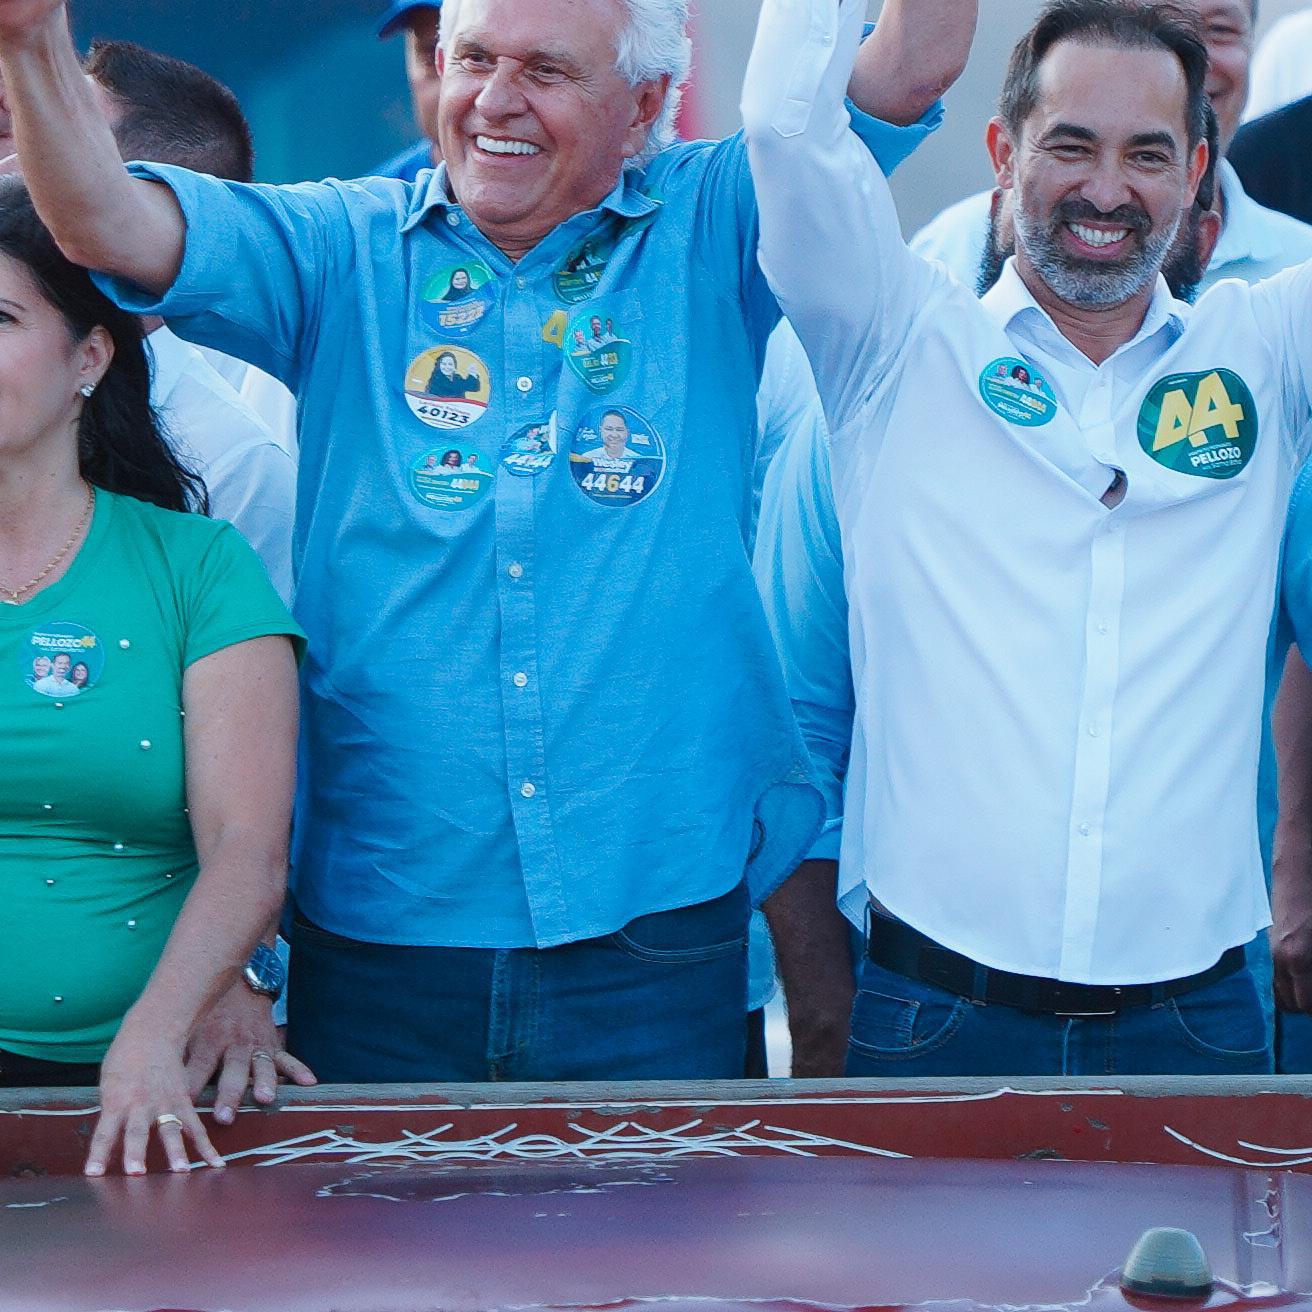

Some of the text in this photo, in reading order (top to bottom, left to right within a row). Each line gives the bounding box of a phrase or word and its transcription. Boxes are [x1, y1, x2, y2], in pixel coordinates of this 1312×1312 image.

[418, 406, 470, 424] 40123
[1153, 371, 1245, 451] 44
[1190, 446, 1242, 467] PELLOZO
[581, 472, 645, 494] 44644
